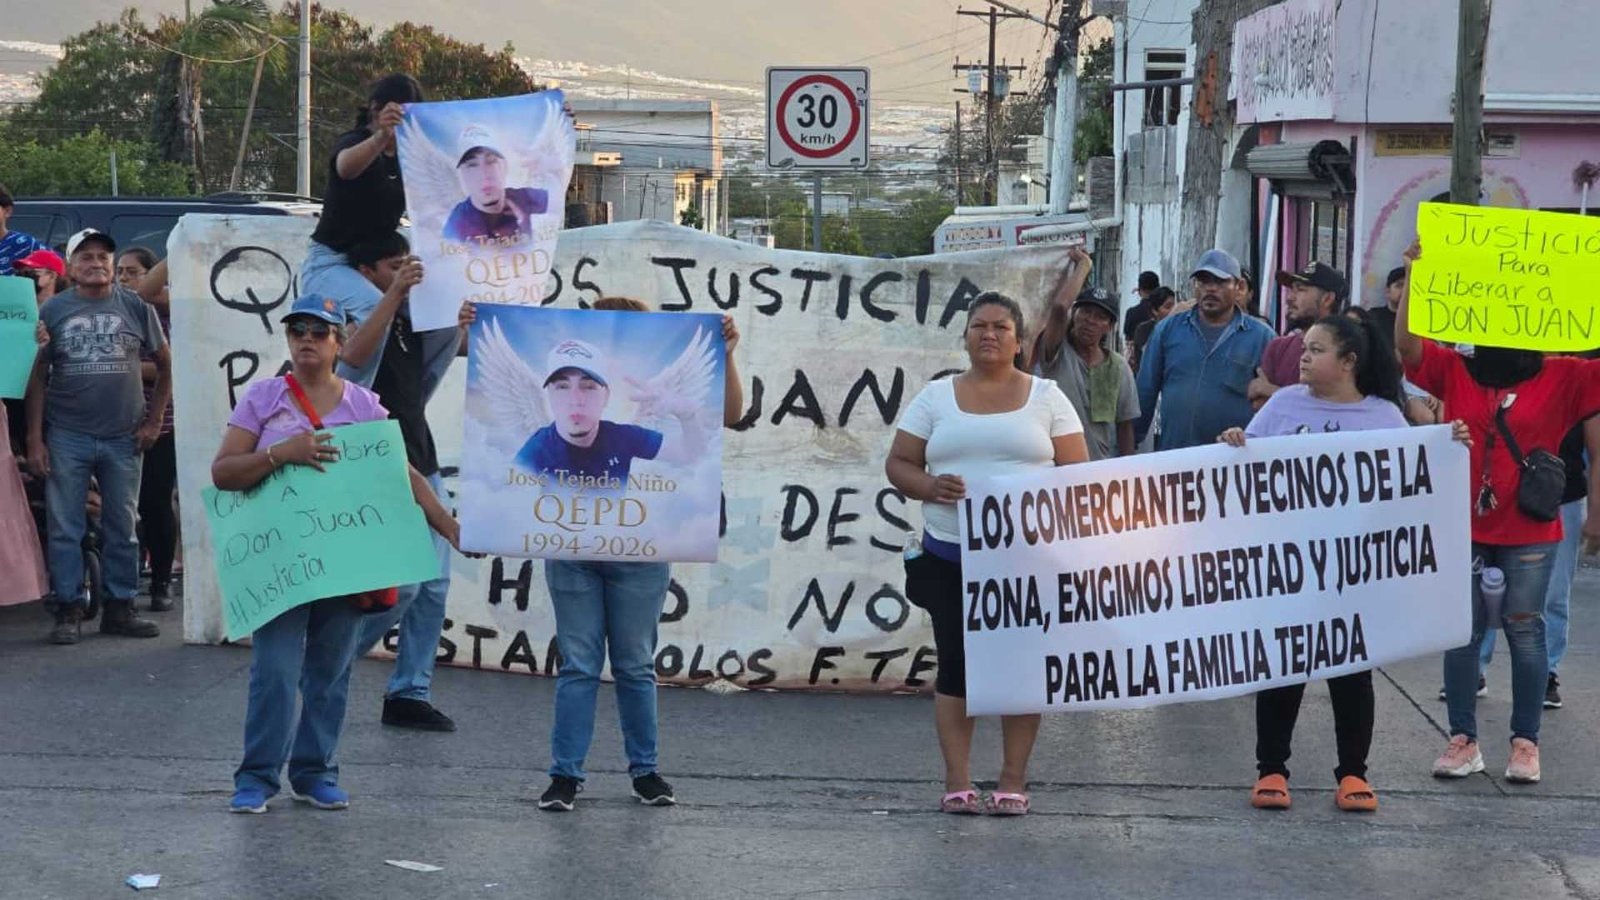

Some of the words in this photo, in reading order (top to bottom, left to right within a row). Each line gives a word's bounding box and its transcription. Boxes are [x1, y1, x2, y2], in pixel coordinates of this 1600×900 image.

[796, 93, 838, 129] 30
[800, 133, 836, 145] km/h
[465, 248, 549, 287] QEPD
[1499, 251, 1550, 277] Para
[651, 256, 983, 328] JUSTICIA
[1427, 298, 1488, 334] DON
[1503, 304, 1594, 341] JUAN
[281, 485, 298, 501] A
[504, 467, 548, 488] José
[554, 468, 621, 493] Tejada
[627, 470, 677, 493] Niño
[965, 493, 1014, 551] LOS
[1020, 468, 1206, 546] COMERCIANTES
[1212, 466, 1228, 518] Y
[1234, 451, 1349, 516] VECINOS
[1354, 448, 1393, 503] DE
[1398, 444, 1432, 498] LA
[533, 494, 647, 532] QEPD
[224, 527, 282, 566] Don
[295, 503, 383, 538] Juan
[522, 533, 657, 557] 1994-2026
[967, 575, 1050, 634] ZONA,
[1058, 556, 1173, 624] EXIGIMOS
[1178, 542, 1304, 607] LIBERTAD
[1308, 539, 1327, 591] Y
[1335, 524, 1437, 596] JUSTICIA
[655, 644, 777, 685] OLOS
[1045, 650, 1120, 705] PARA
[1127, 644, 1160, 697] LA
[1165, 628, 1271, 694] FAMILIA
[1274, 613, 1368, 678] TEJADA
